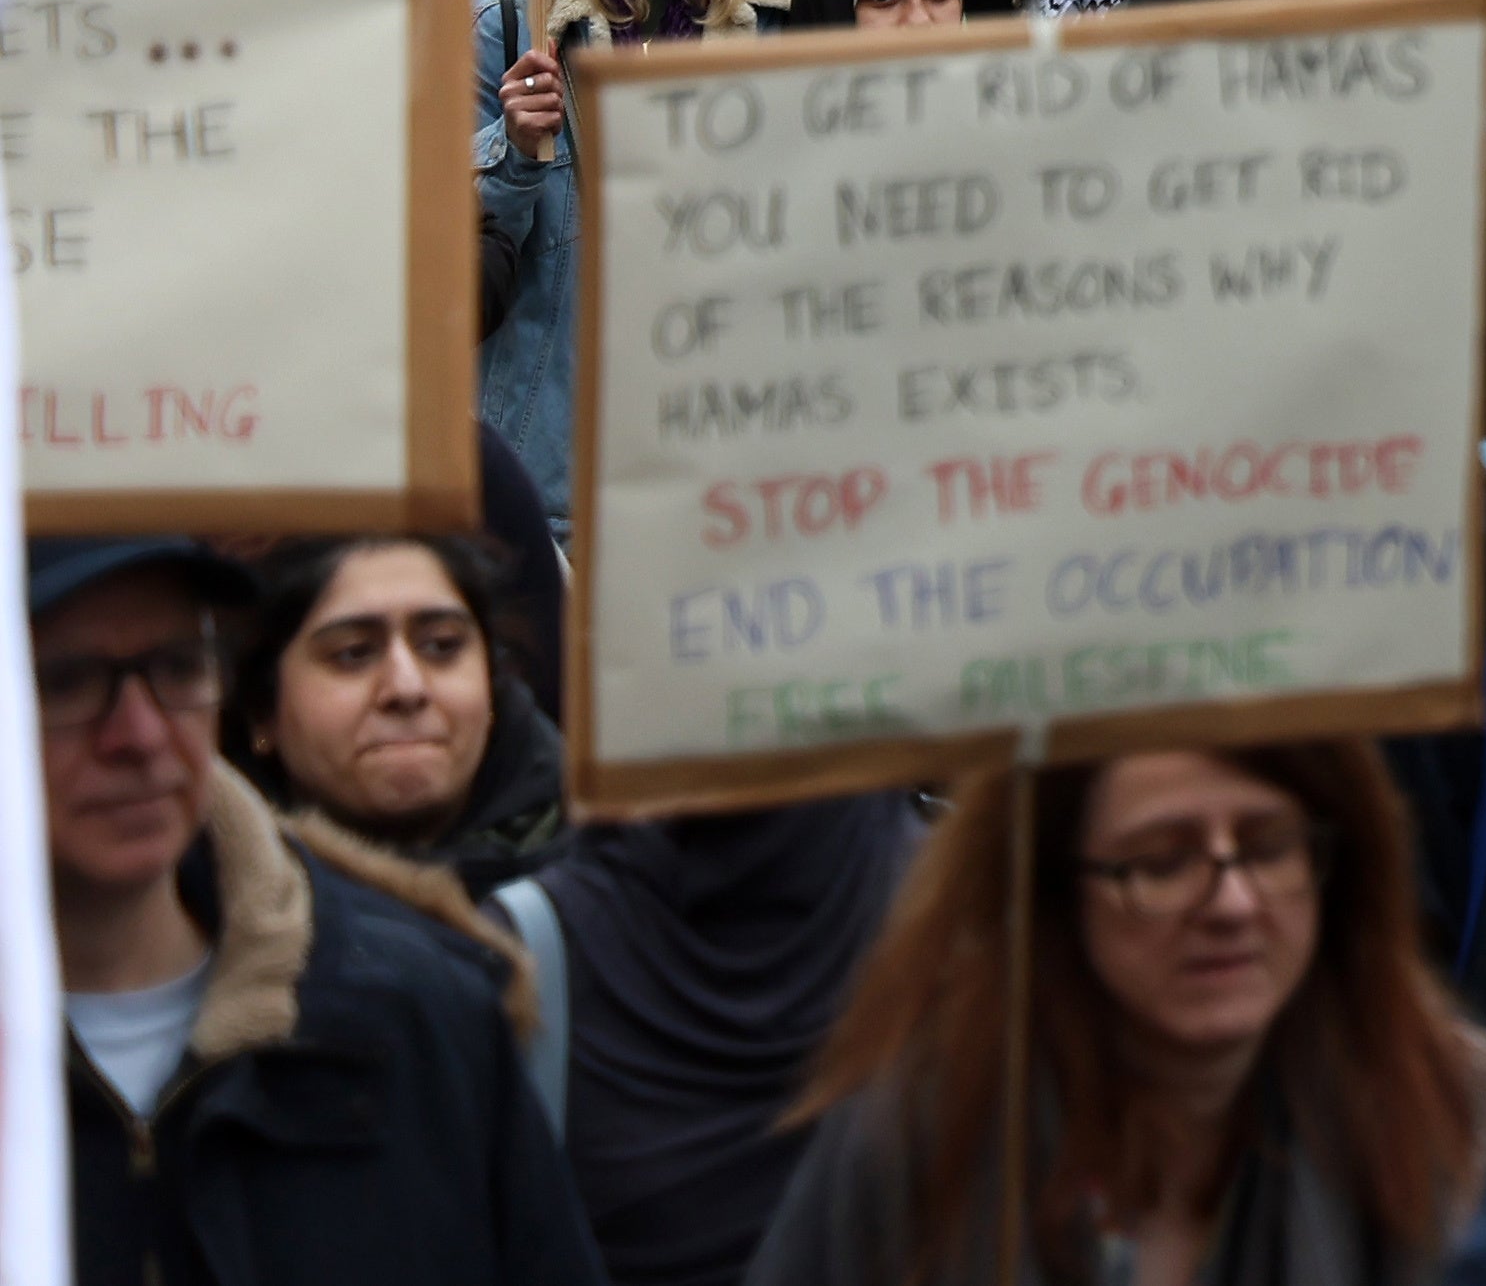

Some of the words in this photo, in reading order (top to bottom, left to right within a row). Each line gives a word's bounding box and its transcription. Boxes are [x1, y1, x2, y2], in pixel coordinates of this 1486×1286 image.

[87, 101, 239, 167] THE
[650, 80, 764, 156] TO
[802, 68, 942, 138] GET
[1216, 33, 1435, 113] HAMAS
[654, 187, 789, 257] YOU
[834, 172, 1001, 251] NEED
[1146, 150, 1275, 215] GET
[698, 465, 890, 549] STOP
[924, 447, 1062, 524] THE
[1081, 433, 1426, 519] GENOCIDE
